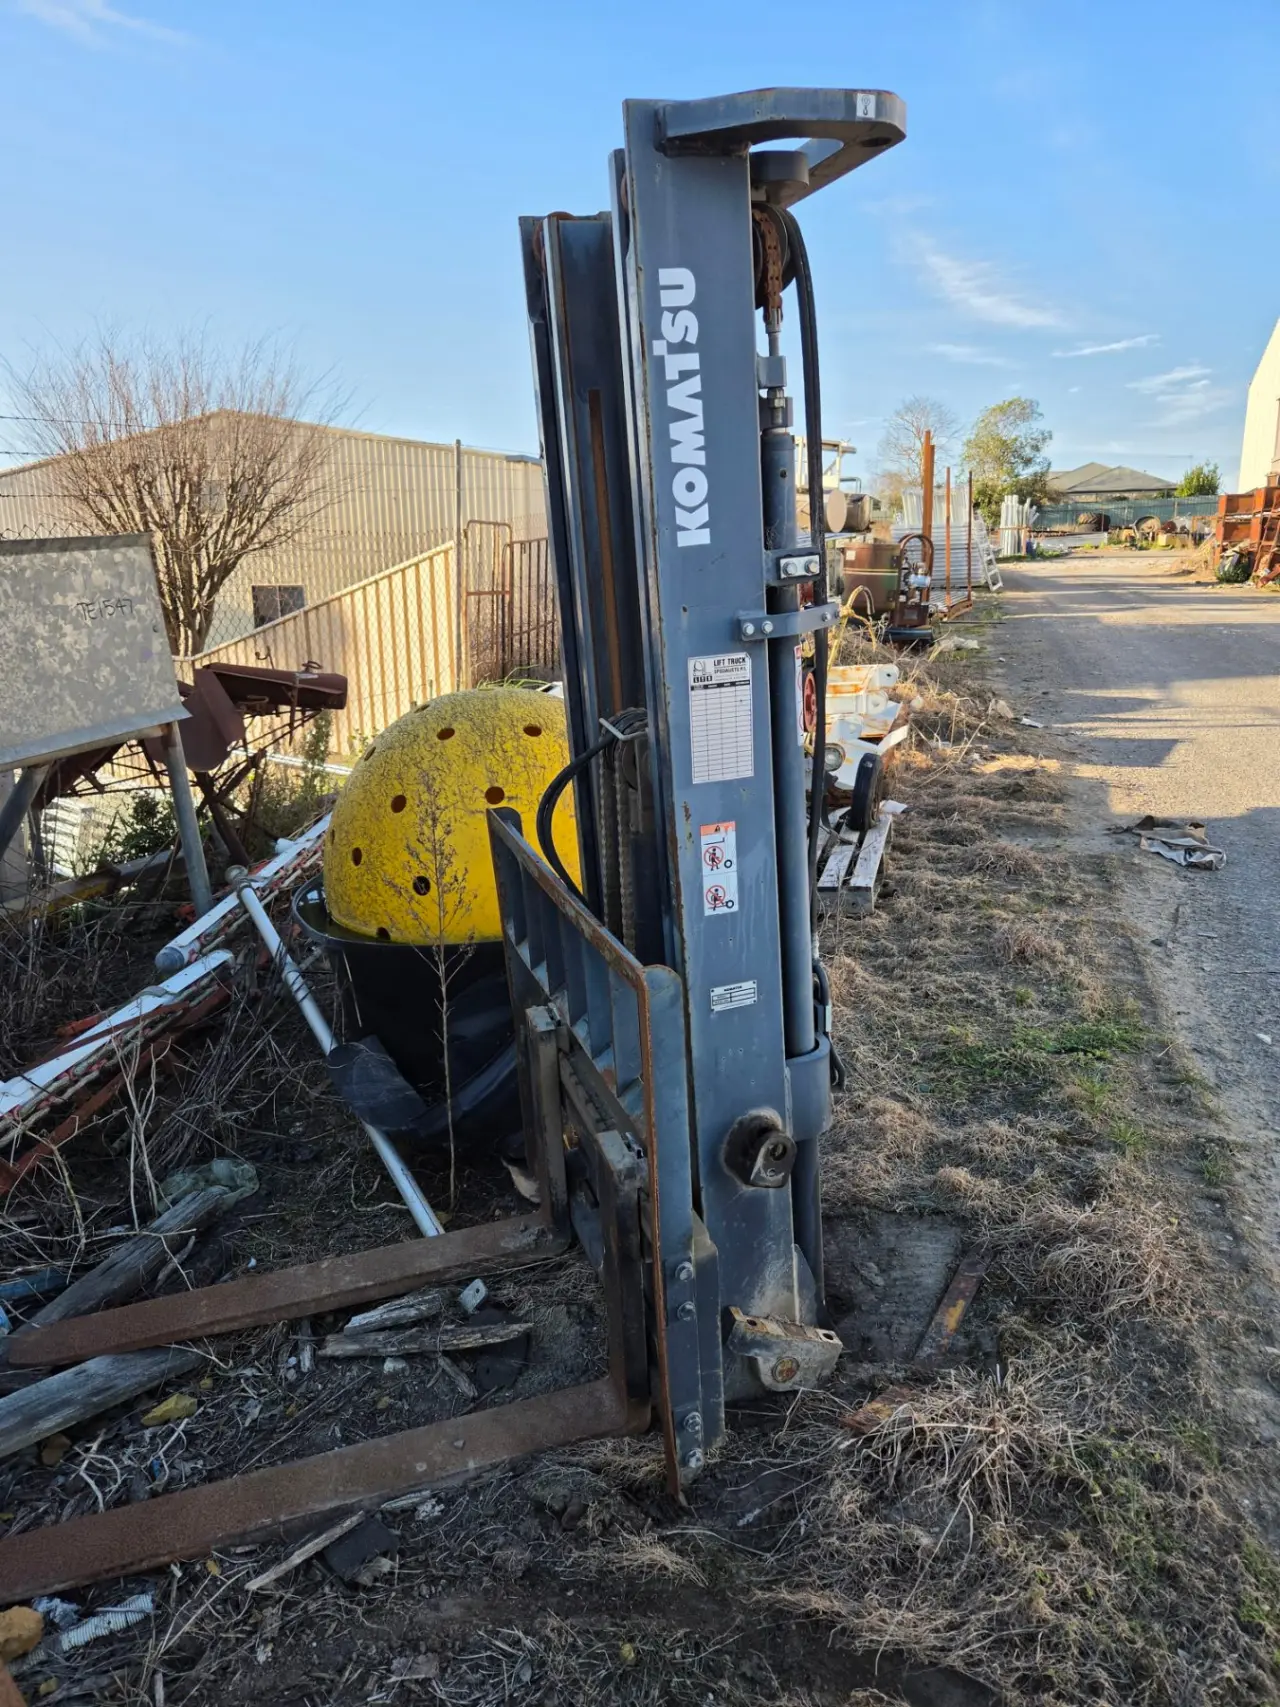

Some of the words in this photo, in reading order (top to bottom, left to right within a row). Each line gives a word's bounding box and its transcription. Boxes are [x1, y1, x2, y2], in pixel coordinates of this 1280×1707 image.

[652, 267, 711, 547] KOMATSU
[76, 598, 133, 621] TE1547
[714, 658, 725, 666] LIFT
